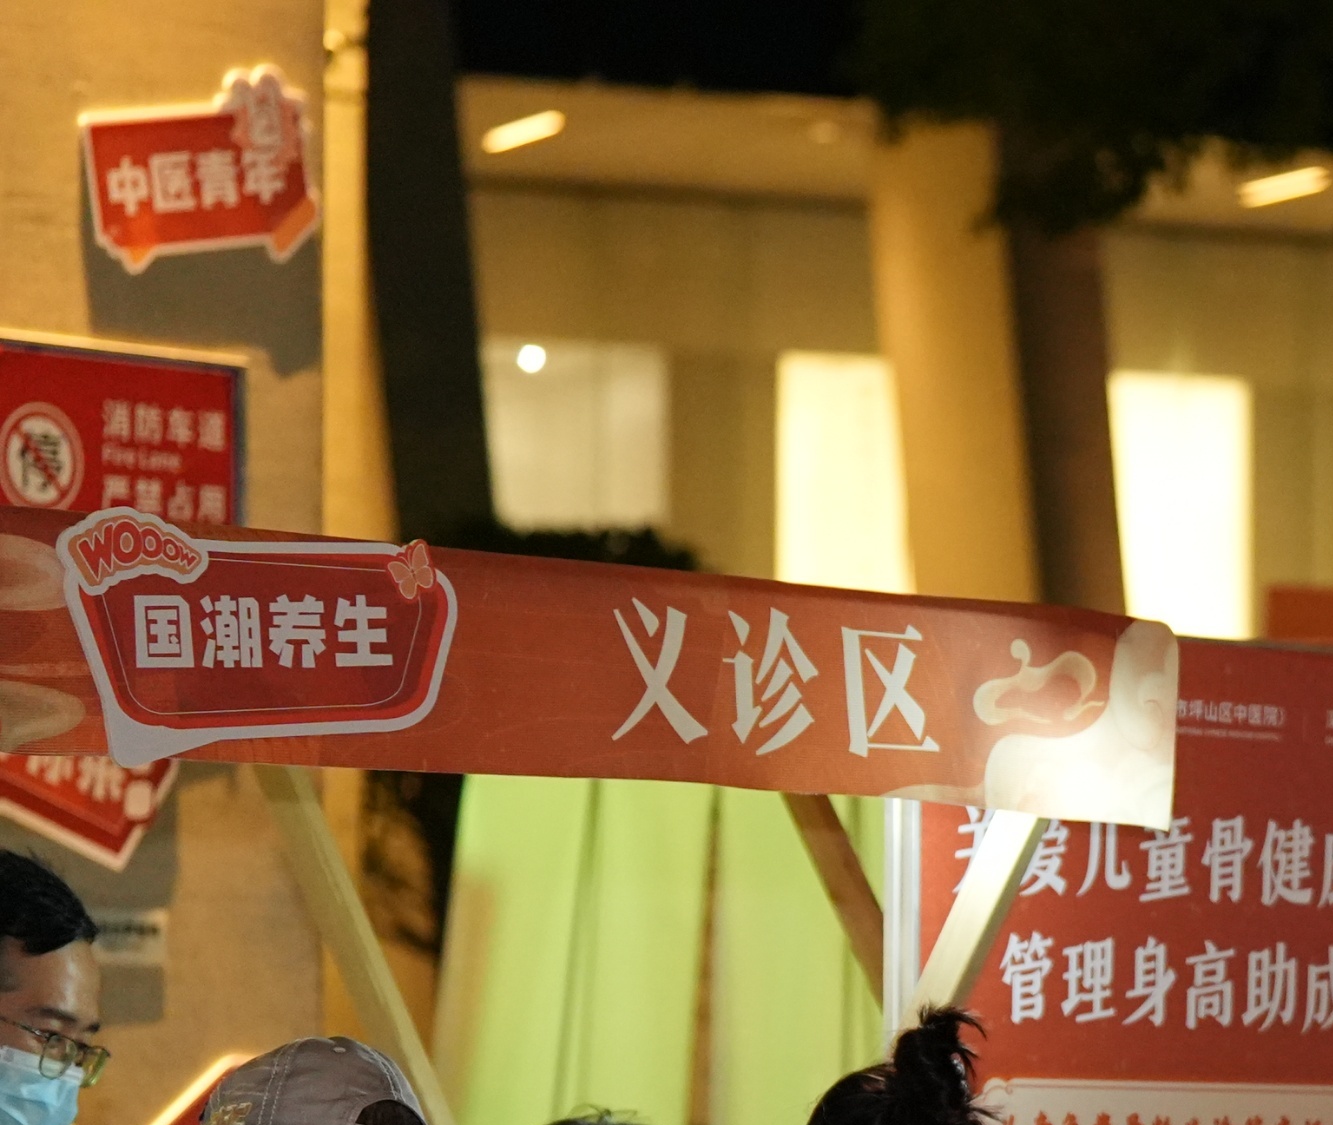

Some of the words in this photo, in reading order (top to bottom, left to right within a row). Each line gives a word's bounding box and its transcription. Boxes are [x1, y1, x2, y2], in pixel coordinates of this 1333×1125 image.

[102, 399, 227, 451] 消防车道
[101, 474, 228, 524] 严禁占用
[133, 594, 394, 669] 国潮养生
[611, 596, 941, 758] 义诊区
